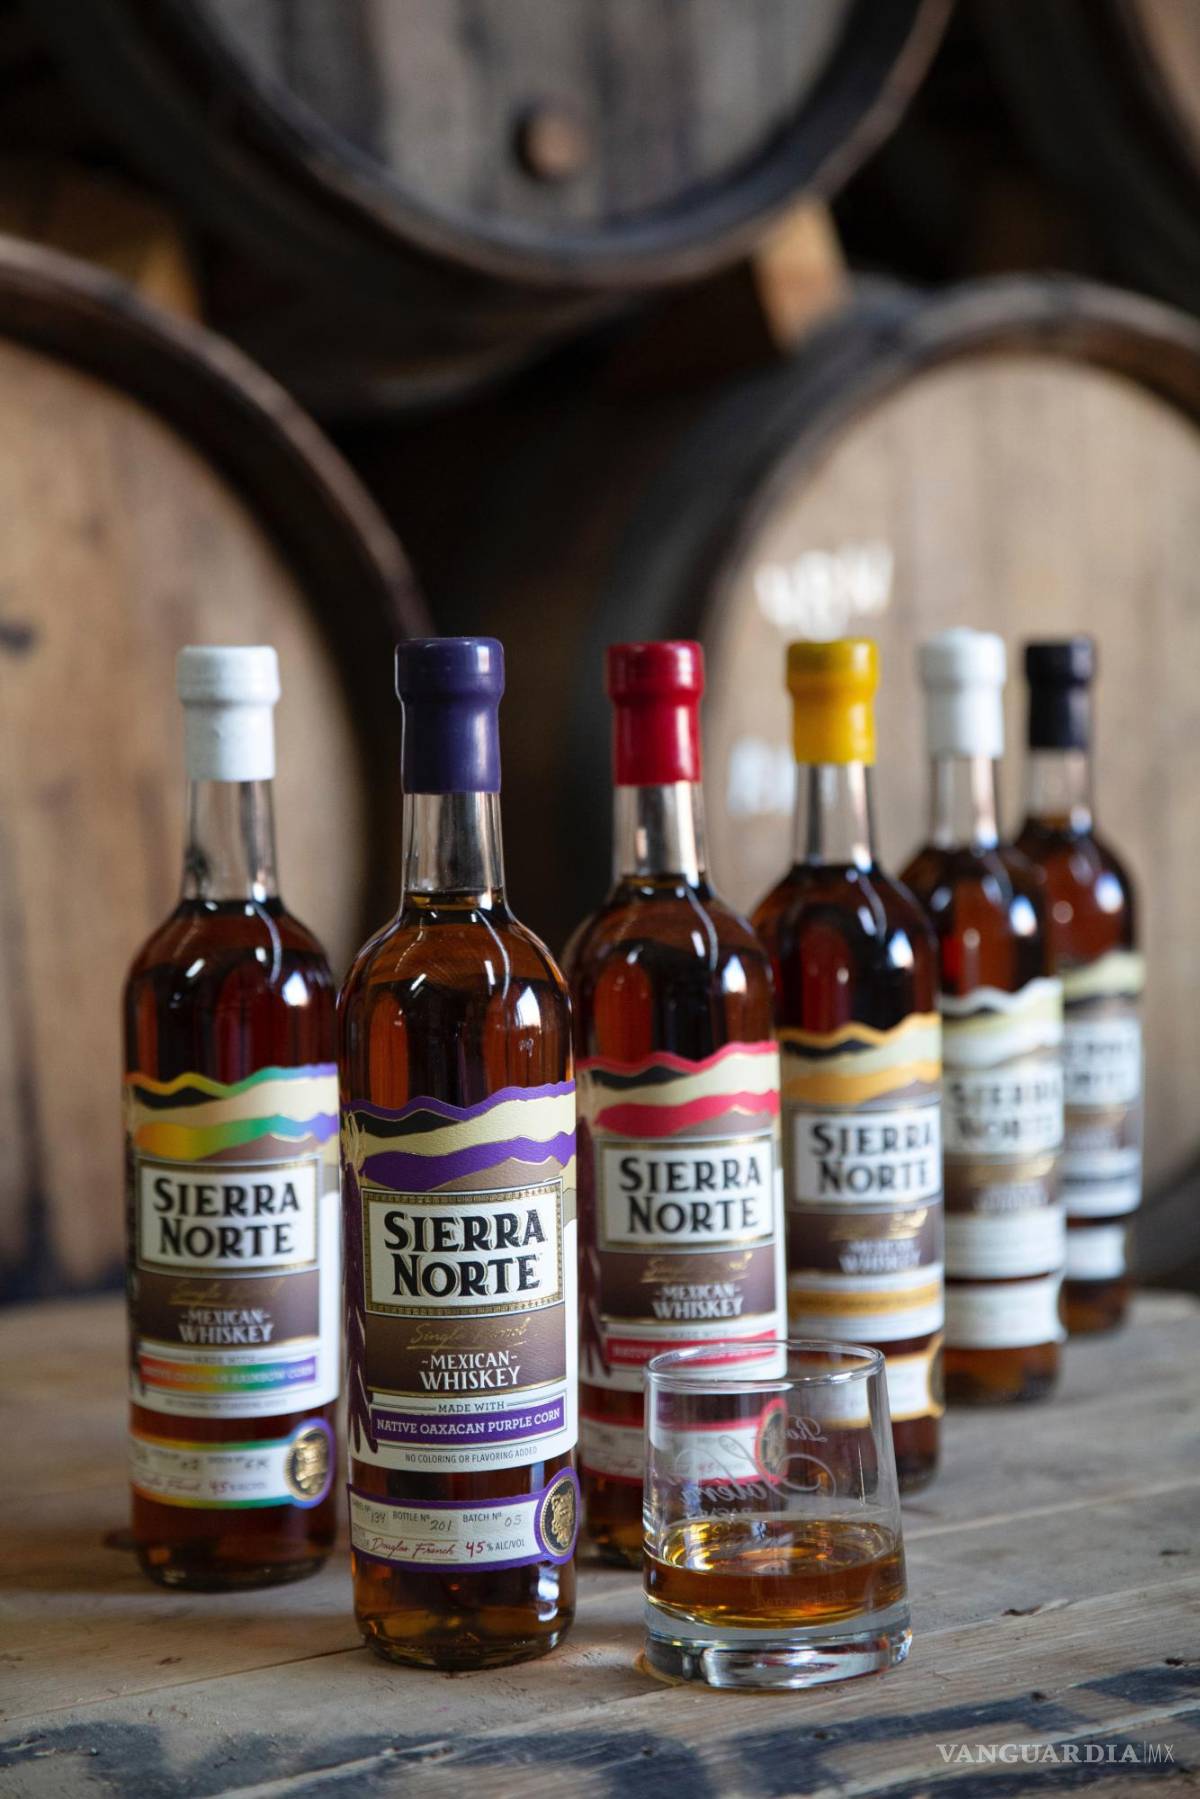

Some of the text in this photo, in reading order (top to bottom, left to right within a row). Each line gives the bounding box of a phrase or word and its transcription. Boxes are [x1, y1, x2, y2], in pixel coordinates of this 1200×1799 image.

[619, 1156, 761, 1194] SIERRA
[153, 1176, 300, 1216] SIERRA
[625, 1195, 760, 1234] NORTE
[157, 1216, 295, 1258] NORTE
[383, 1208, 547, 1250] SIERRA
[391, 1252, 541, 1297] NORTE
[651, 1297, 743, 1319] WHISKEY
[178, 1323, 273, 1344] WHISKEY
[419, 1365, 521, 1390] WHISKEY
[438, 1401, 505, 1413] MADE WITH
[376, 1407, 561, 1435] NATIVE OAXACAN PURPLE CORN
[417, 1454, 457, 1464] COLORING
[470, 1449, 513, 1463] FLAVORING
[514, 1445, 538, 1458] ADDED
[392, 1511, 418, 1521] BOTTLE
[430, 1519, 452, 1531] 201
[462, 1513, 490, 1523] BATCH
